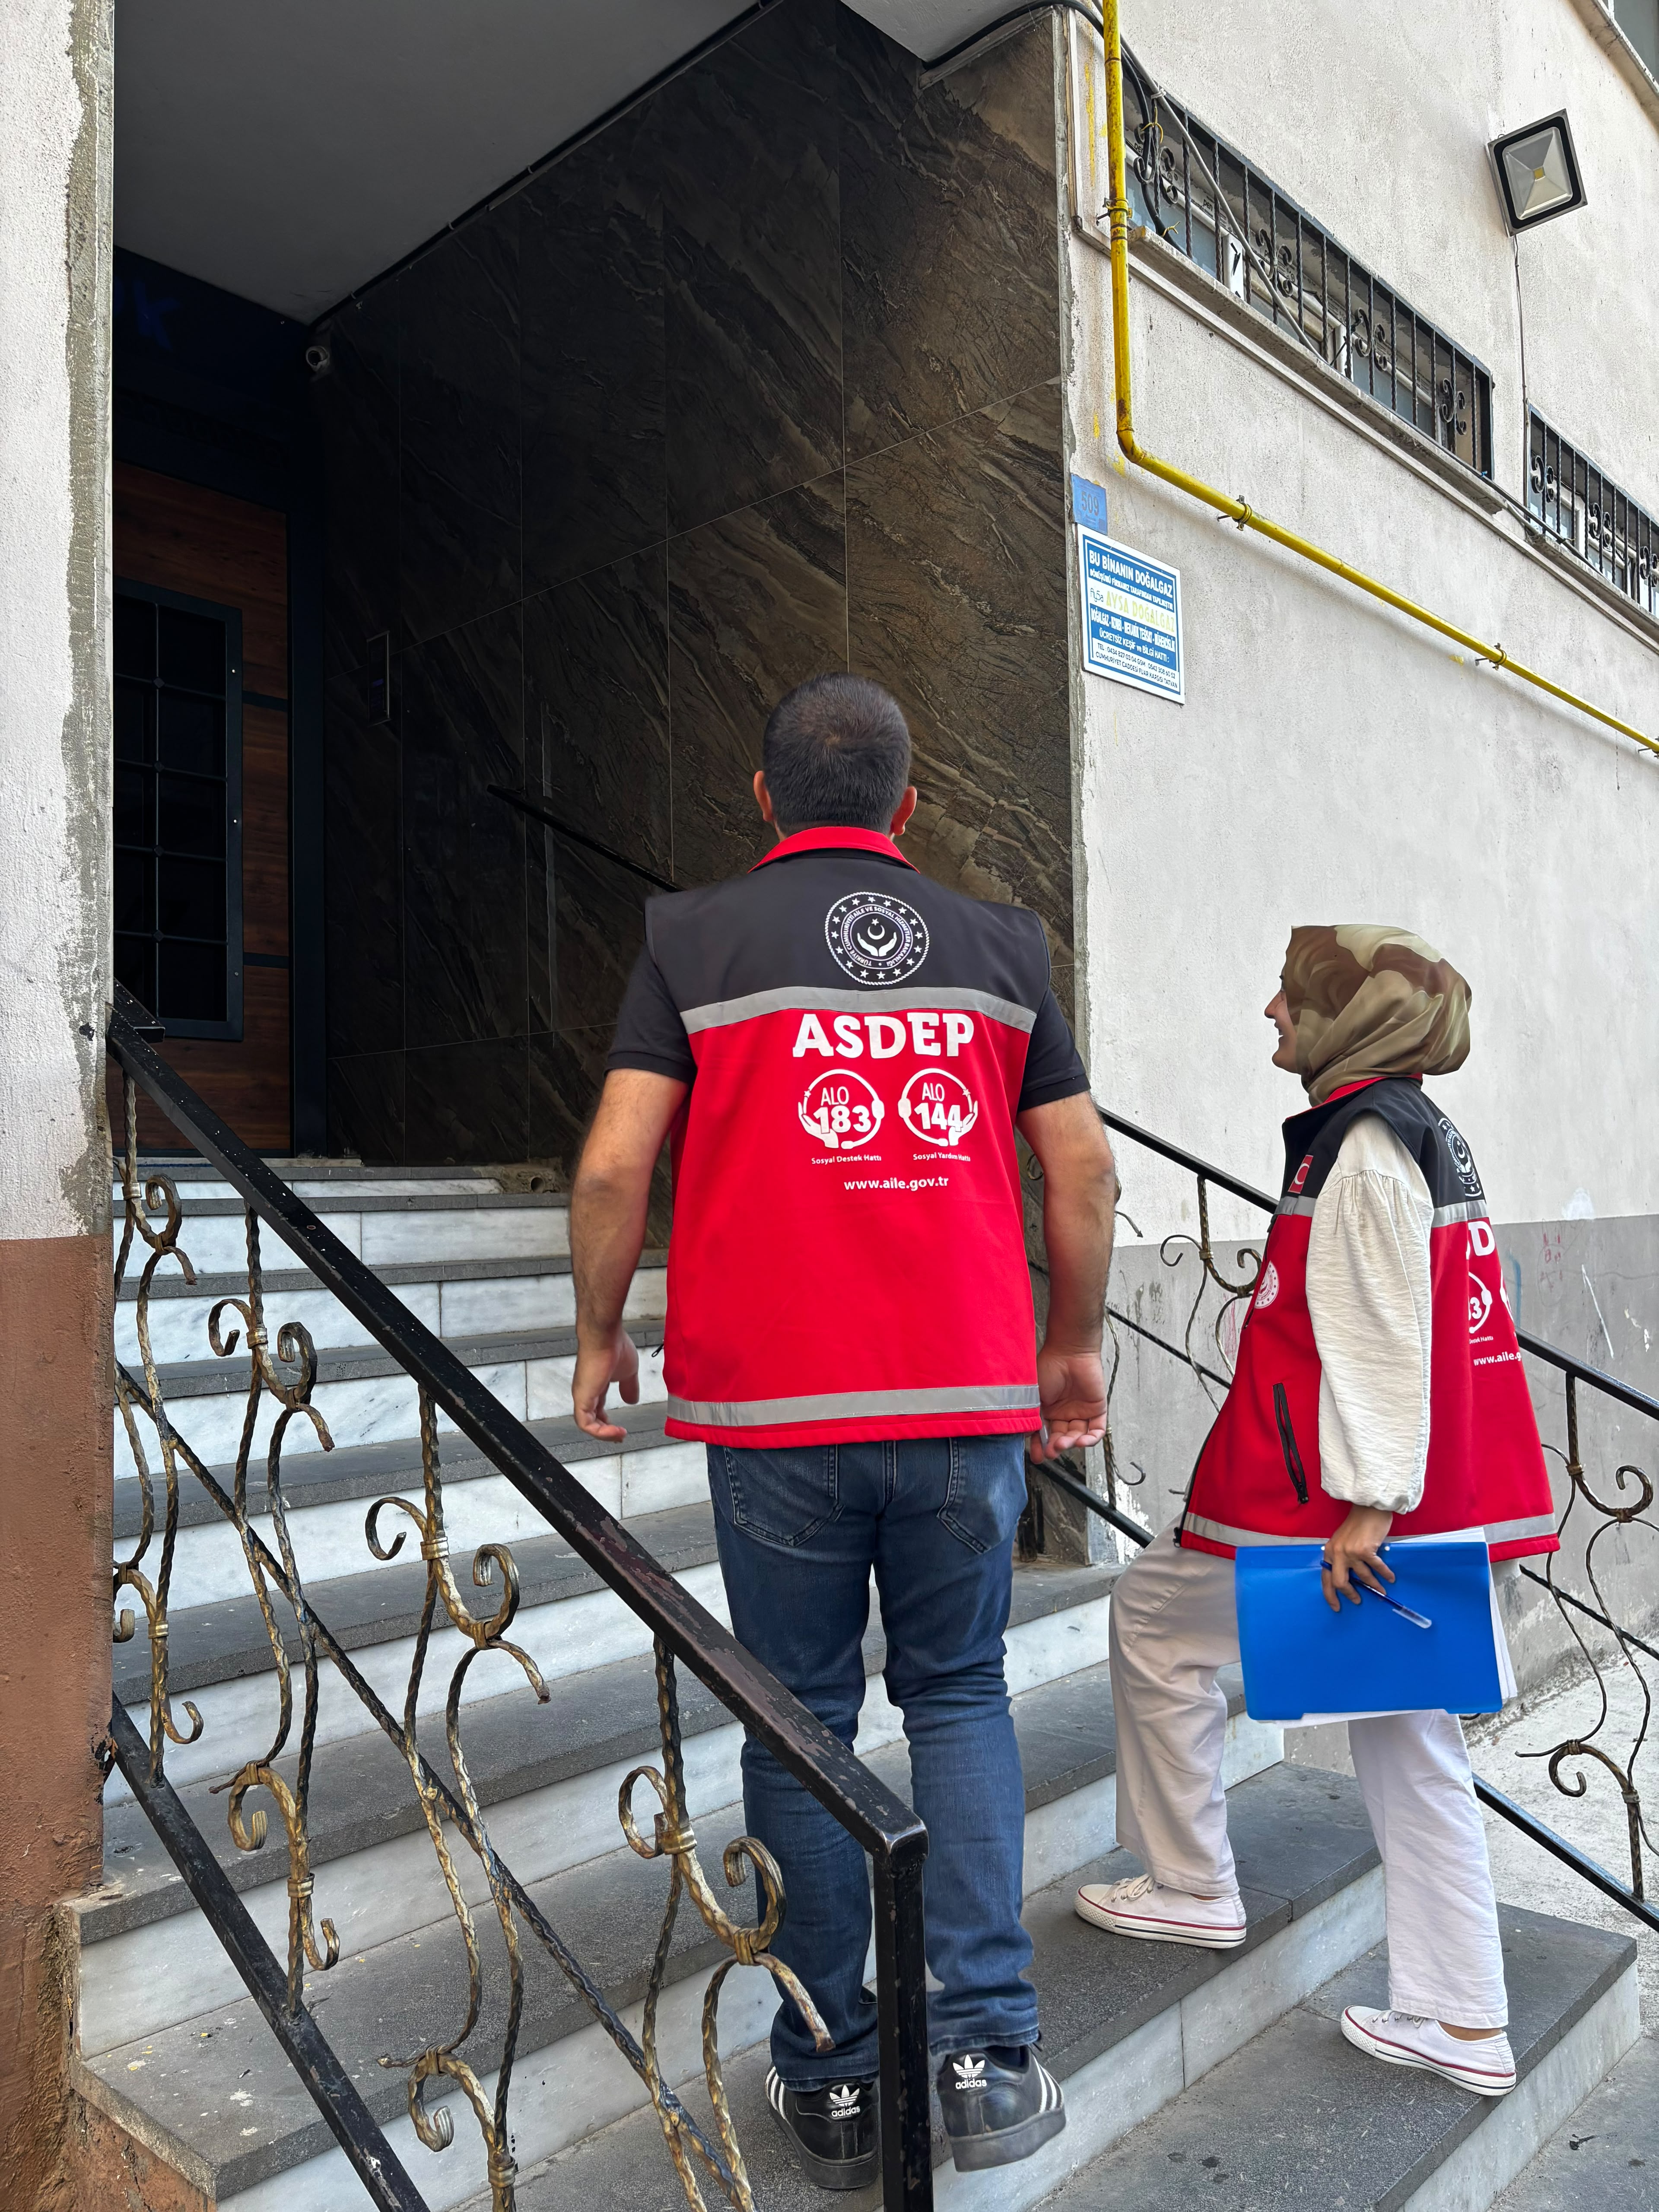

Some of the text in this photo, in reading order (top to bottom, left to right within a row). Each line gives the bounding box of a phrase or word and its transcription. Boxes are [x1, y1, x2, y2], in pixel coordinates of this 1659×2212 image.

[1081, 491, 1099, 516] 509
[1089, 550, 1173, 598] BU BİNANIN DOĞALGAZ
[1106, 591, 1129, 614] AYSA
[1090, 607, 1109, 627] DOĞALGAZ
[1099, 627, 1122, 645] ÜCRETSİZ
[1122, 638, 1136, 650] KEŞİF
[1142, 645, 1154, 657] BİLGİ
[853, 908, 865, 918] AİLE
[874, 906, 895, 918] SOSYAL
[843, 914, 855, 950] CUMHURİYETİ
[894, 916, 912, 943] HİZMETLER
[849, 950, 872, 966] TÜRKİYE
[886, 943, 911, 967] BAKANLIĞI
[792, 1013, 974, 1059] ASDEP
[820, 1086, 849, 1106] ALO
[921, 1082, 945, 1102] ALO
[813, 1105, 872, 1134] 183
[914, 1103, 964, 1132] 144
[811, 1156, 835, 1165] Sosyal
[912, 1152, 937, 1161] Sosyal
[844, 1176, 949, 1192] www.aile.gov.tr
[955, 2078, 987, 2091] adidas
[831, 2105, 861, 2117] adidas
